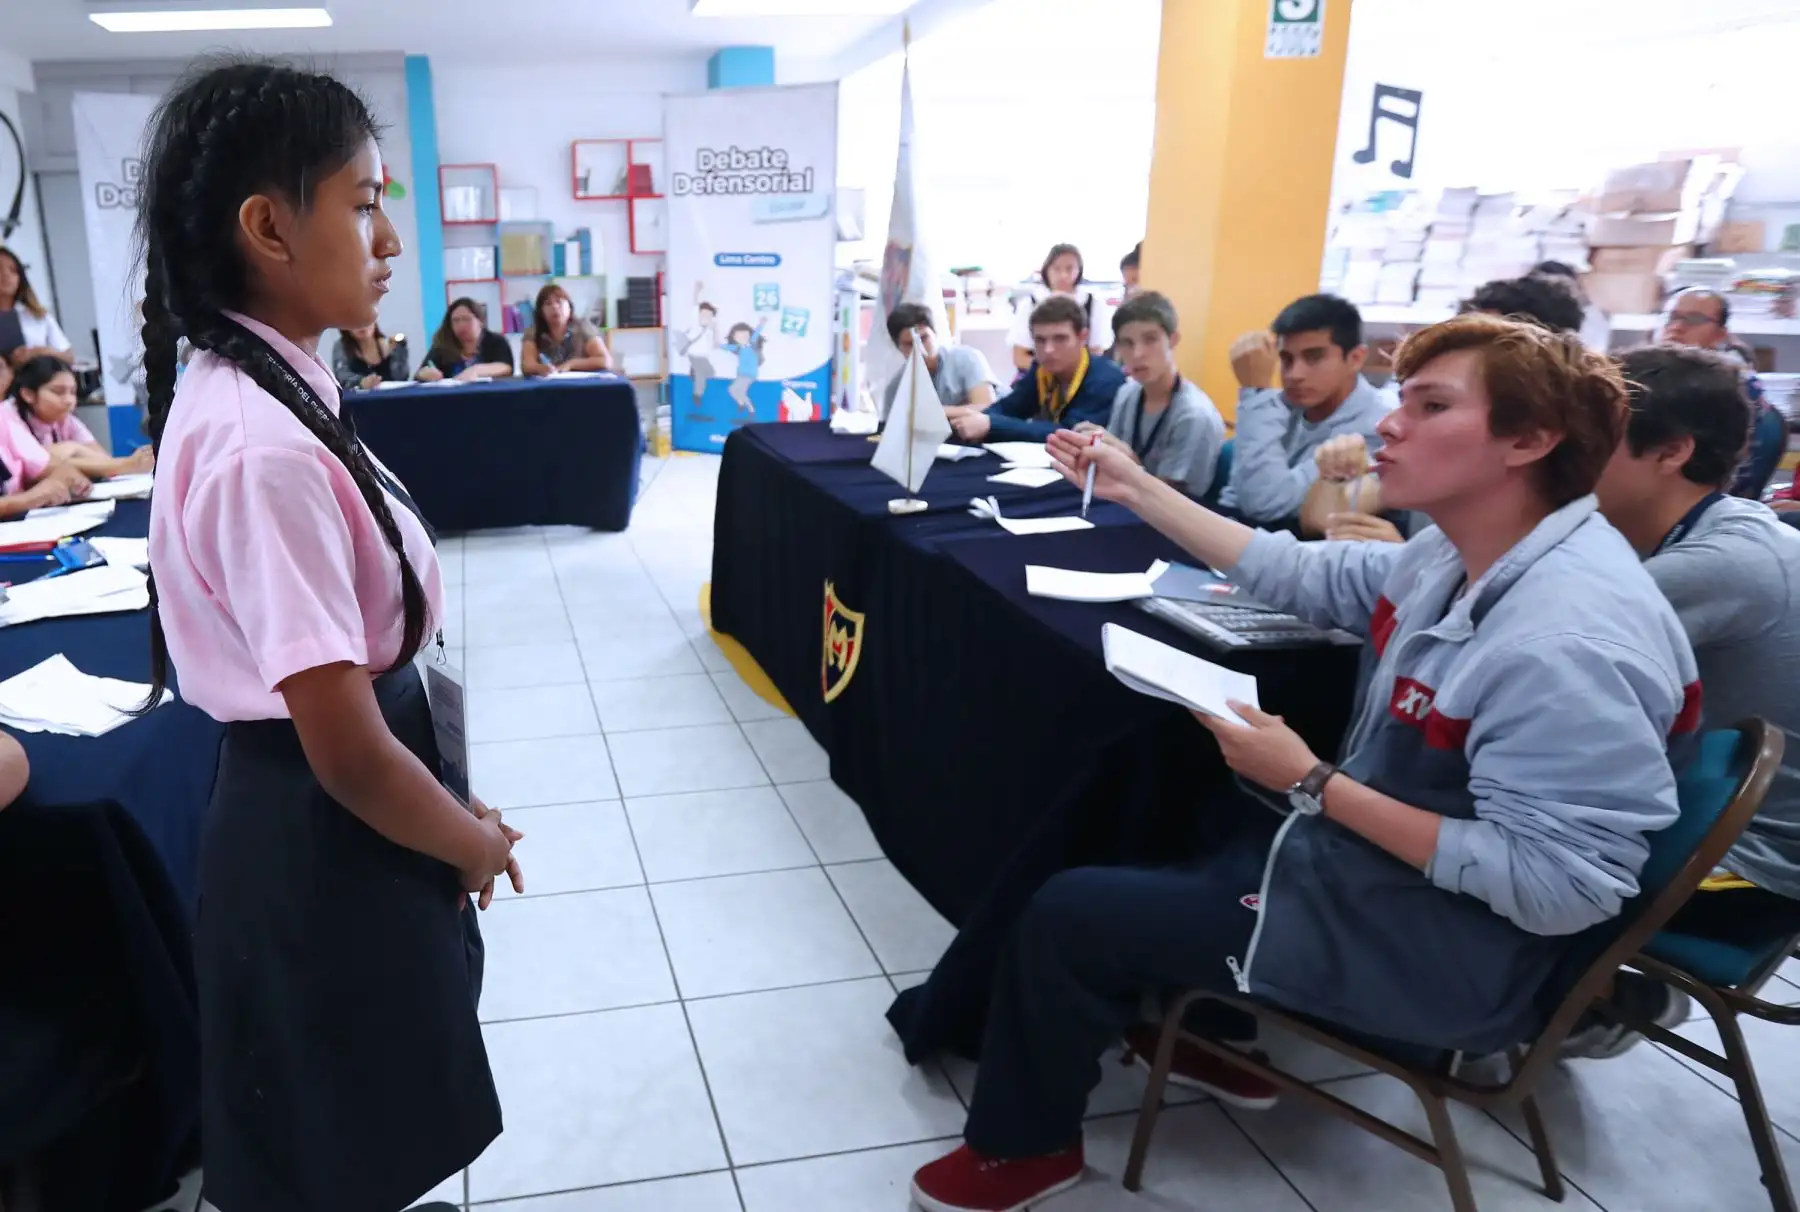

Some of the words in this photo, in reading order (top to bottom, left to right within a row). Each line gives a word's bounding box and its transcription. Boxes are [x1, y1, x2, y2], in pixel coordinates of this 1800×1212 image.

[697, 146, 789, 171] Debate
[673, 166, 814, 196] Defensorial
[297, 387, 311, 403] DEL
